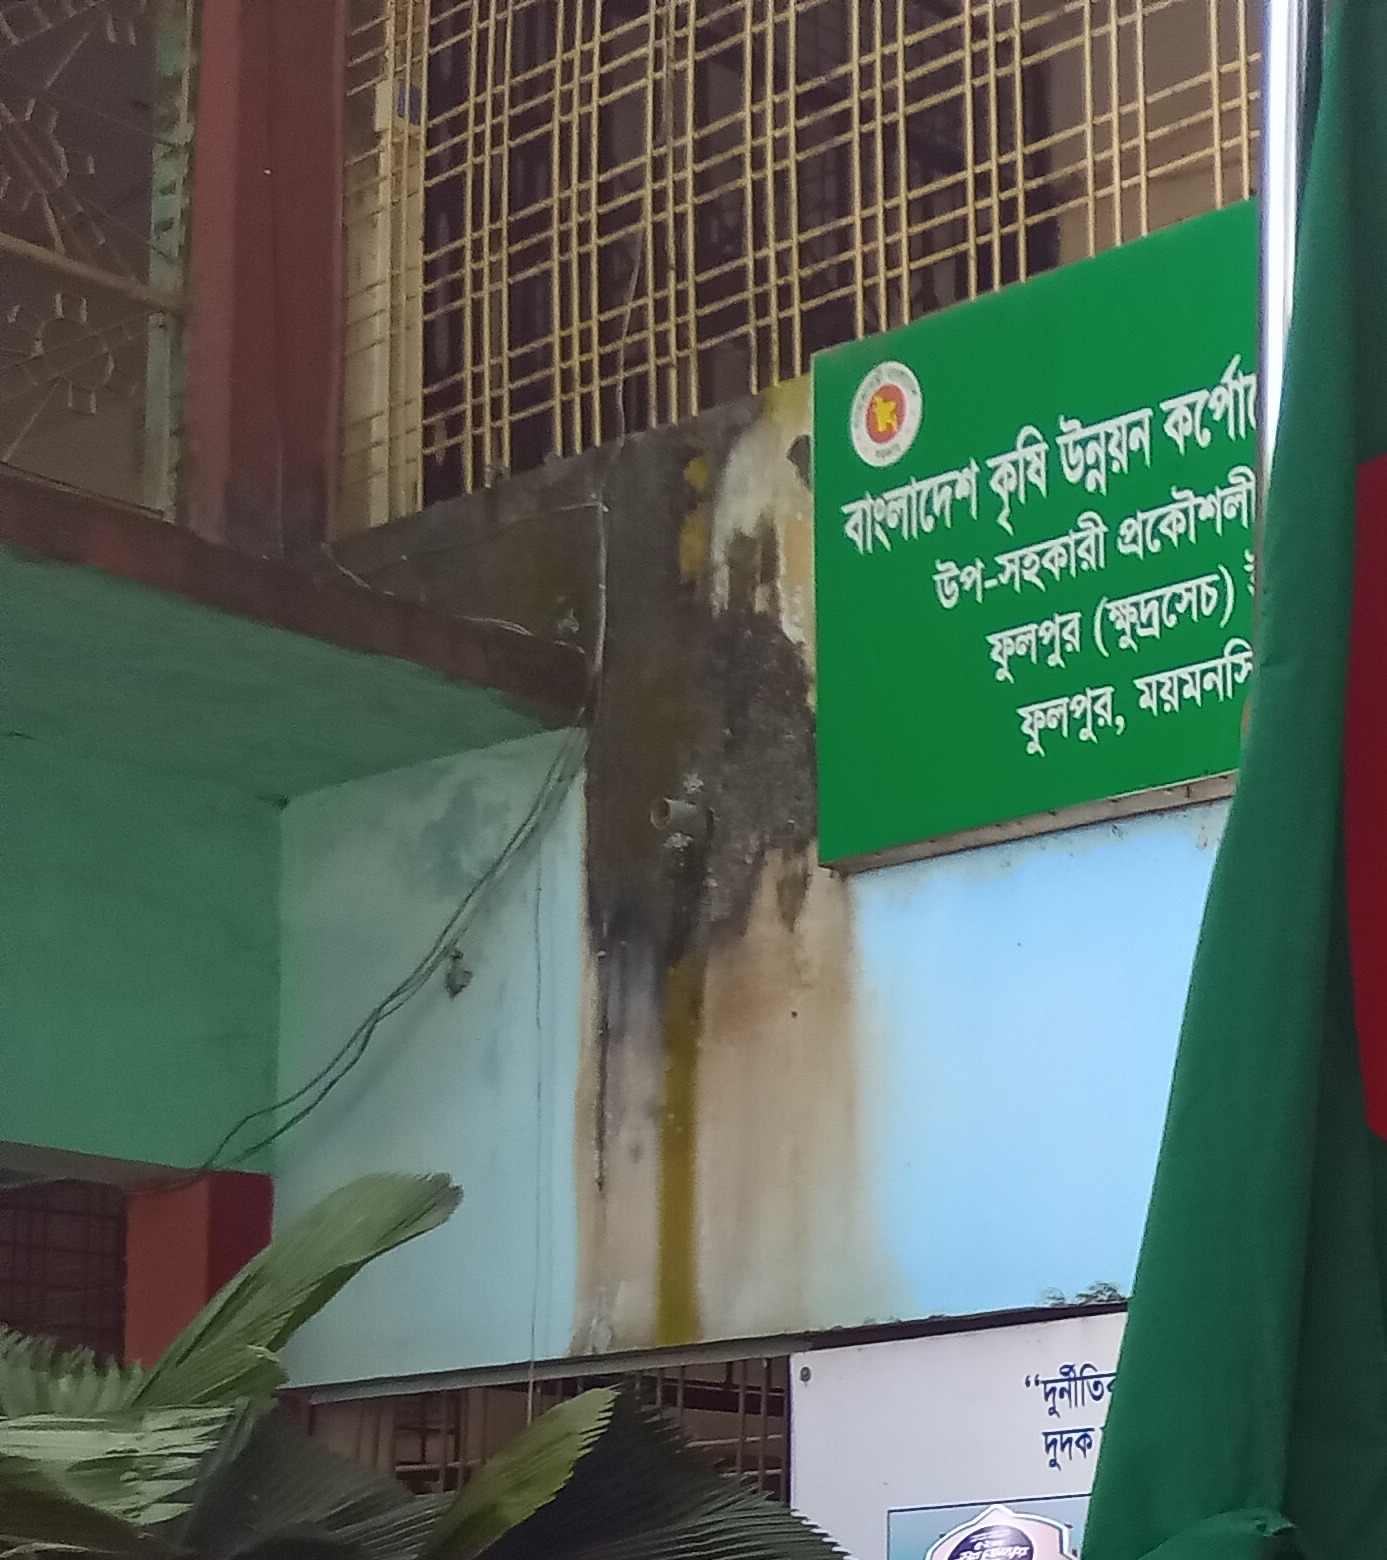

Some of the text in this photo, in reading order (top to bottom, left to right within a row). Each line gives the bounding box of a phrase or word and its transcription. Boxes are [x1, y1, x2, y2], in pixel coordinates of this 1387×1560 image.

[841, 457, 981, 556] বাংলাদেশ
[985, 424, 1050, 537] কৃষি
[1055, 407, 1154, 497] উন্নয়ন
[932, 510, 1110, 610] উপ-সহকারী
[985, 611, 1082, 685] ফুলপুর
[1093, 564, 1235, 658] (ক্ষুদ্রসেচ)
[1016, 637, 1253, 758] ফুলপুর, ময়মনসি
[1041, 1427, 1095, 1471] দুদক
